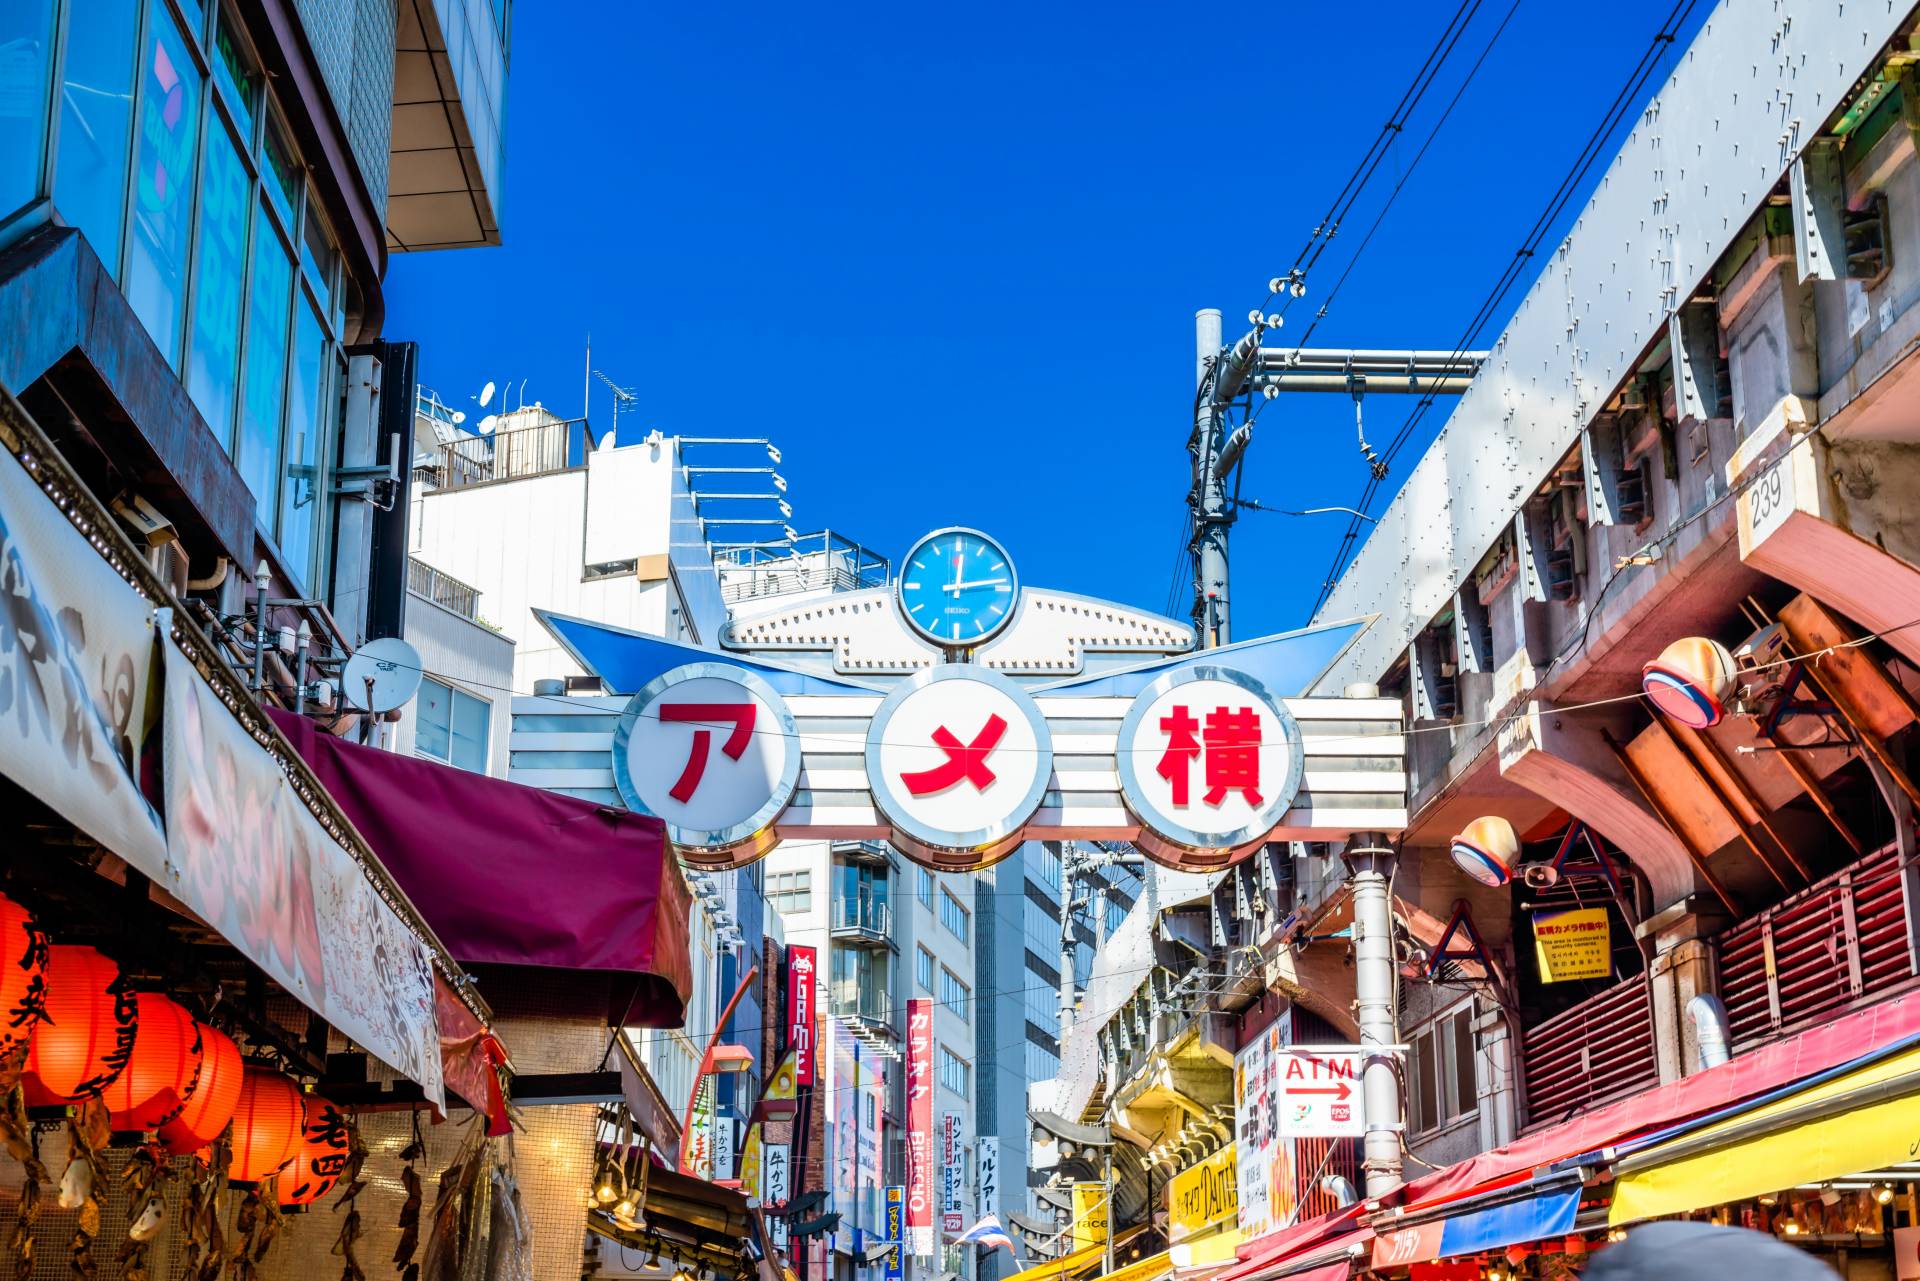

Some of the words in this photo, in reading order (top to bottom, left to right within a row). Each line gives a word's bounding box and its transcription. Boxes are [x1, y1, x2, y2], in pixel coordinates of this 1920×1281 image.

[1752, 470, 1781, 529] 239
[793, 975, 809, 1075] GAME
[910, 1012, 929, 1101] カラオケ
[1285, 1057, 1353, 1080] ATM
[910, 1131, 926, 1163] BIG
[909, 1167, 926, 1212] ECHO
[982, 1158, 996, 1217] ルノアー
